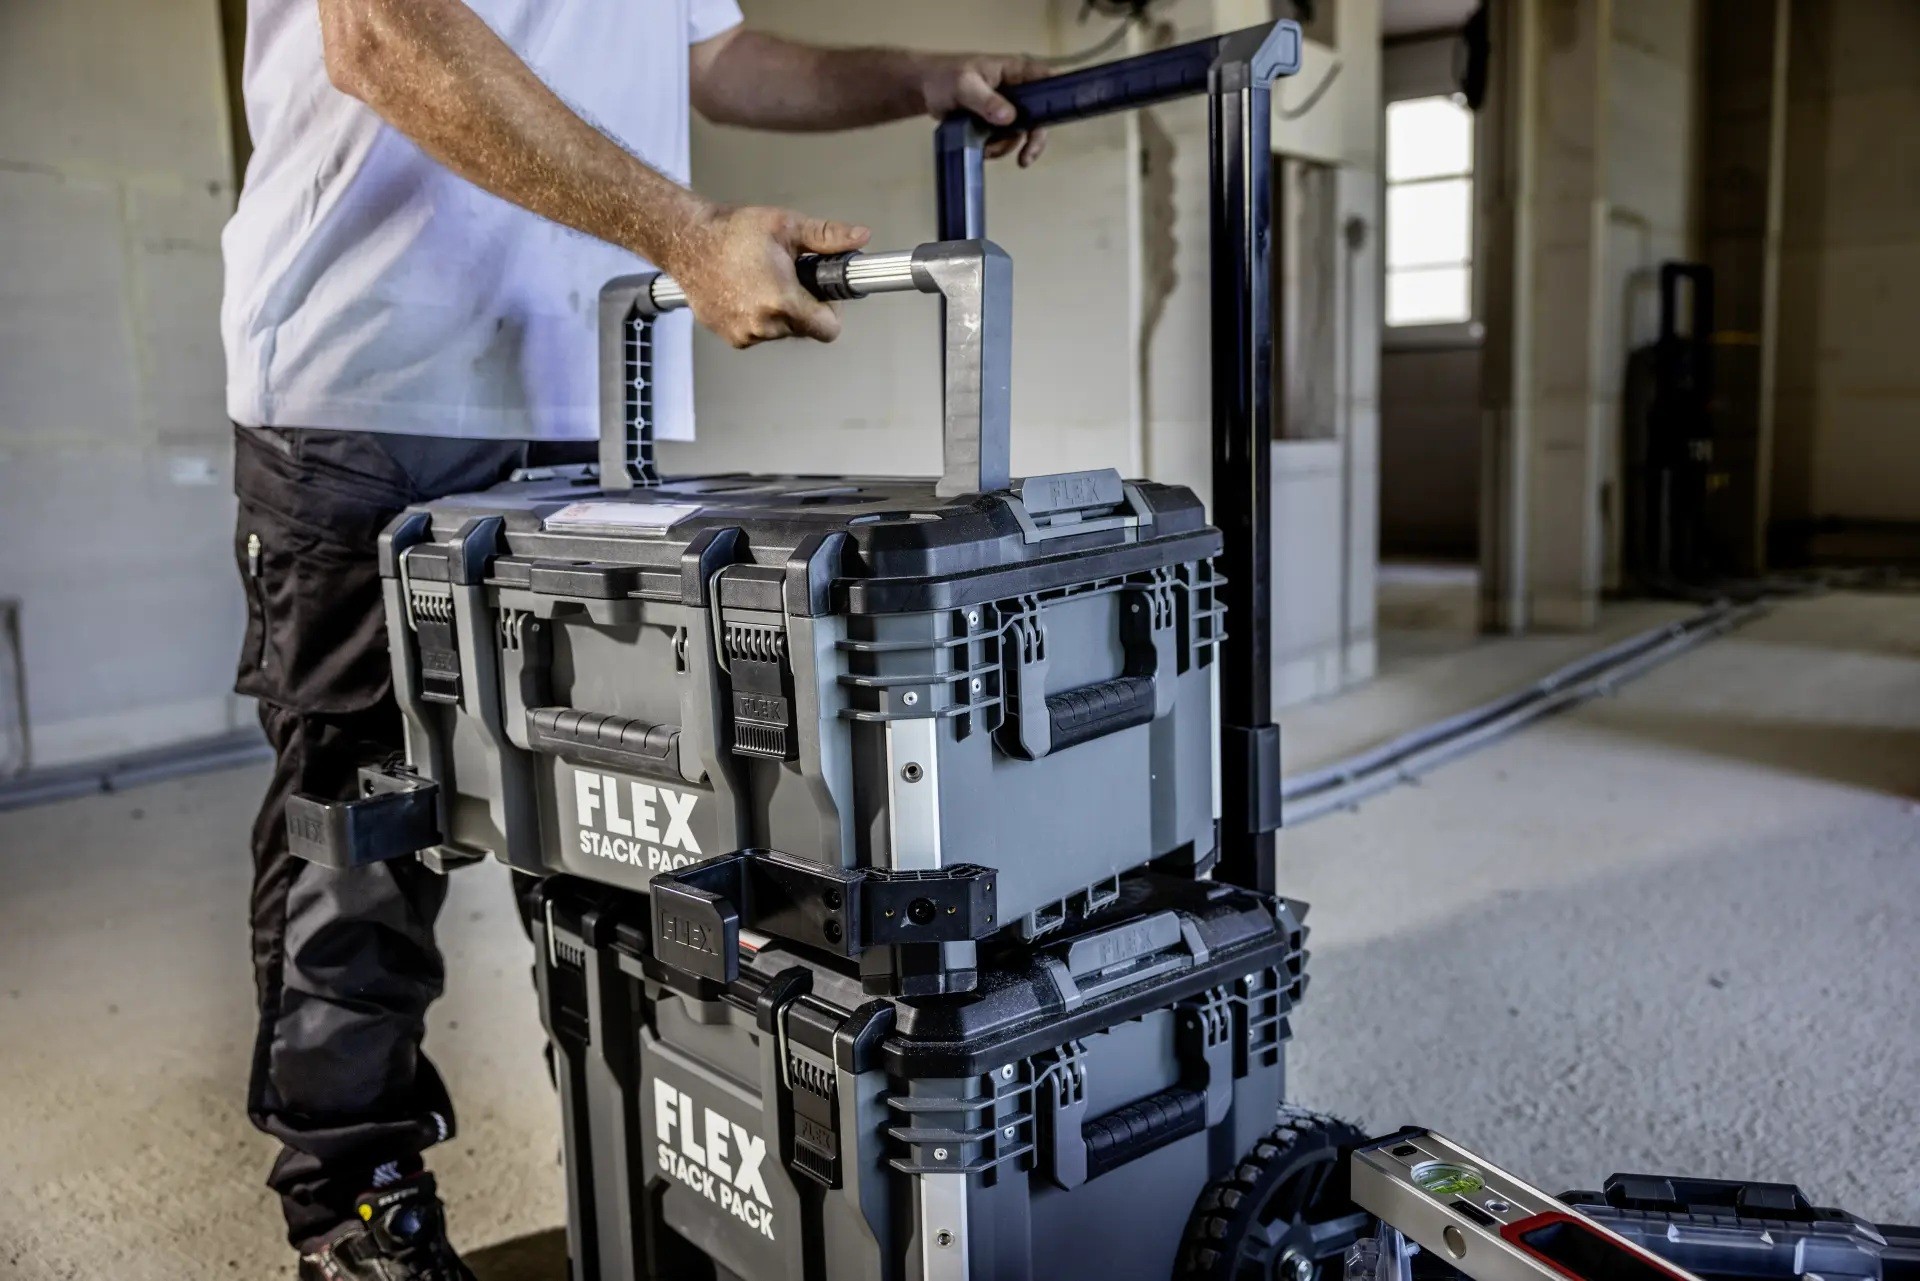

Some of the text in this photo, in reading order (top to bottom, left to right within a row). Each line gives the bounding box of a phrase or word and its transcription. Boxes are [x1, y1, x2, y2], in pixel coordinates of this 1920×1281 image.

[1048, 476, 1101, 507] FLEX
[740, 697, 781, 720] FLEX
[574, 769, 703, 855] FLEX
[579, 828, 703, 873] STACK PAC
[660, 907, 720, 957] FLEX
[1099, 925, 1153, 966] FLEX
[653, 1076, 773, 1209] FLEX
[801, 1119, 832, 1150] FLEX
[657, 1143, 775, 1241] STACK PACK
